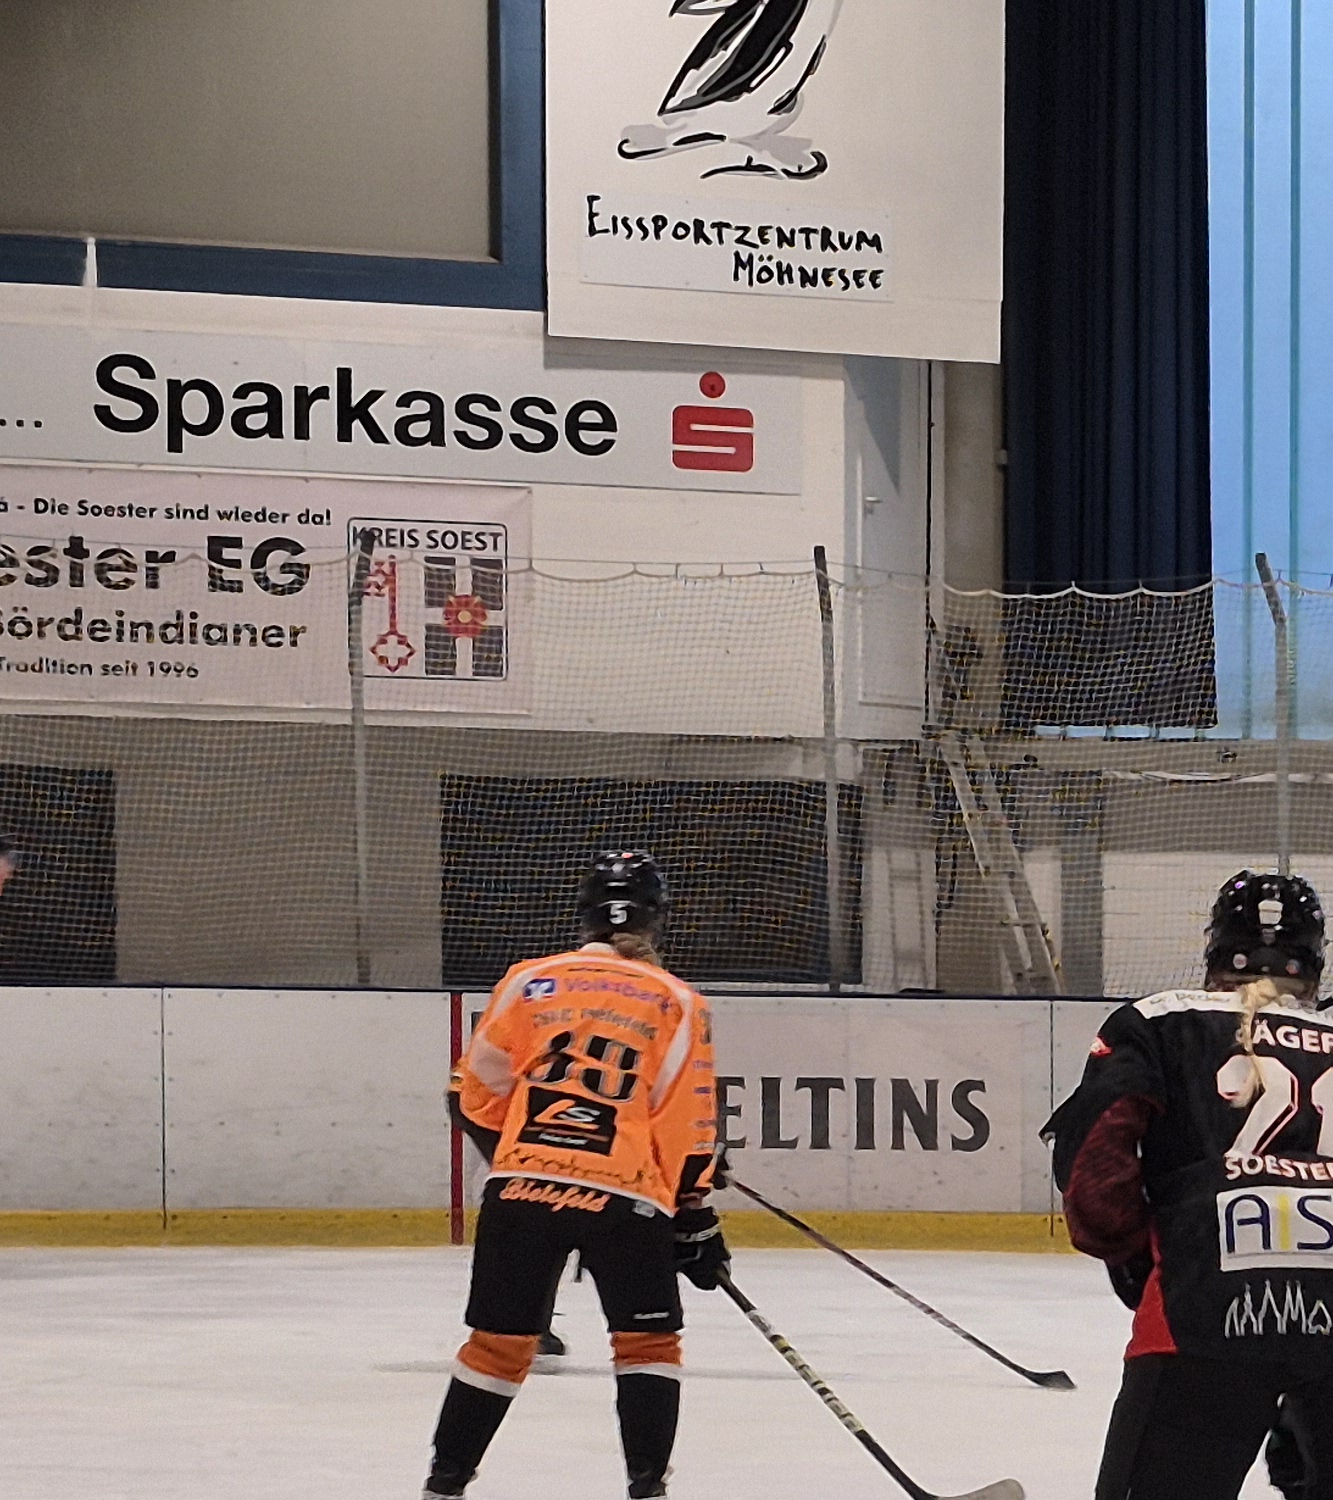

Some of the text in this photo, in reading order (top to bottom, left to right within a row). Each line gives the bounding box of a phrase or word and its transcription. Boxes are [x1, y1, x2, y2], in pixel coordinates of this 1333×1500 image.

[93, 353, 618, 457] Sparkasse
[33, 497, 69, 516] Die
[77, 499, 157, 520] Soester
[164, 502, 209, 520] sind
[216, 506, 290, 525] wieder
[297, 508, 331, 526] da!
[425, 529, 503, 553] SOEST
[206, 535, 311, 597] EG
[0, 605, 307, 649] ördeindianer
[100, 658, 139, 677] seit
[147, 661, 199, 680] 1996
[610, 902, 628, 925] 5
